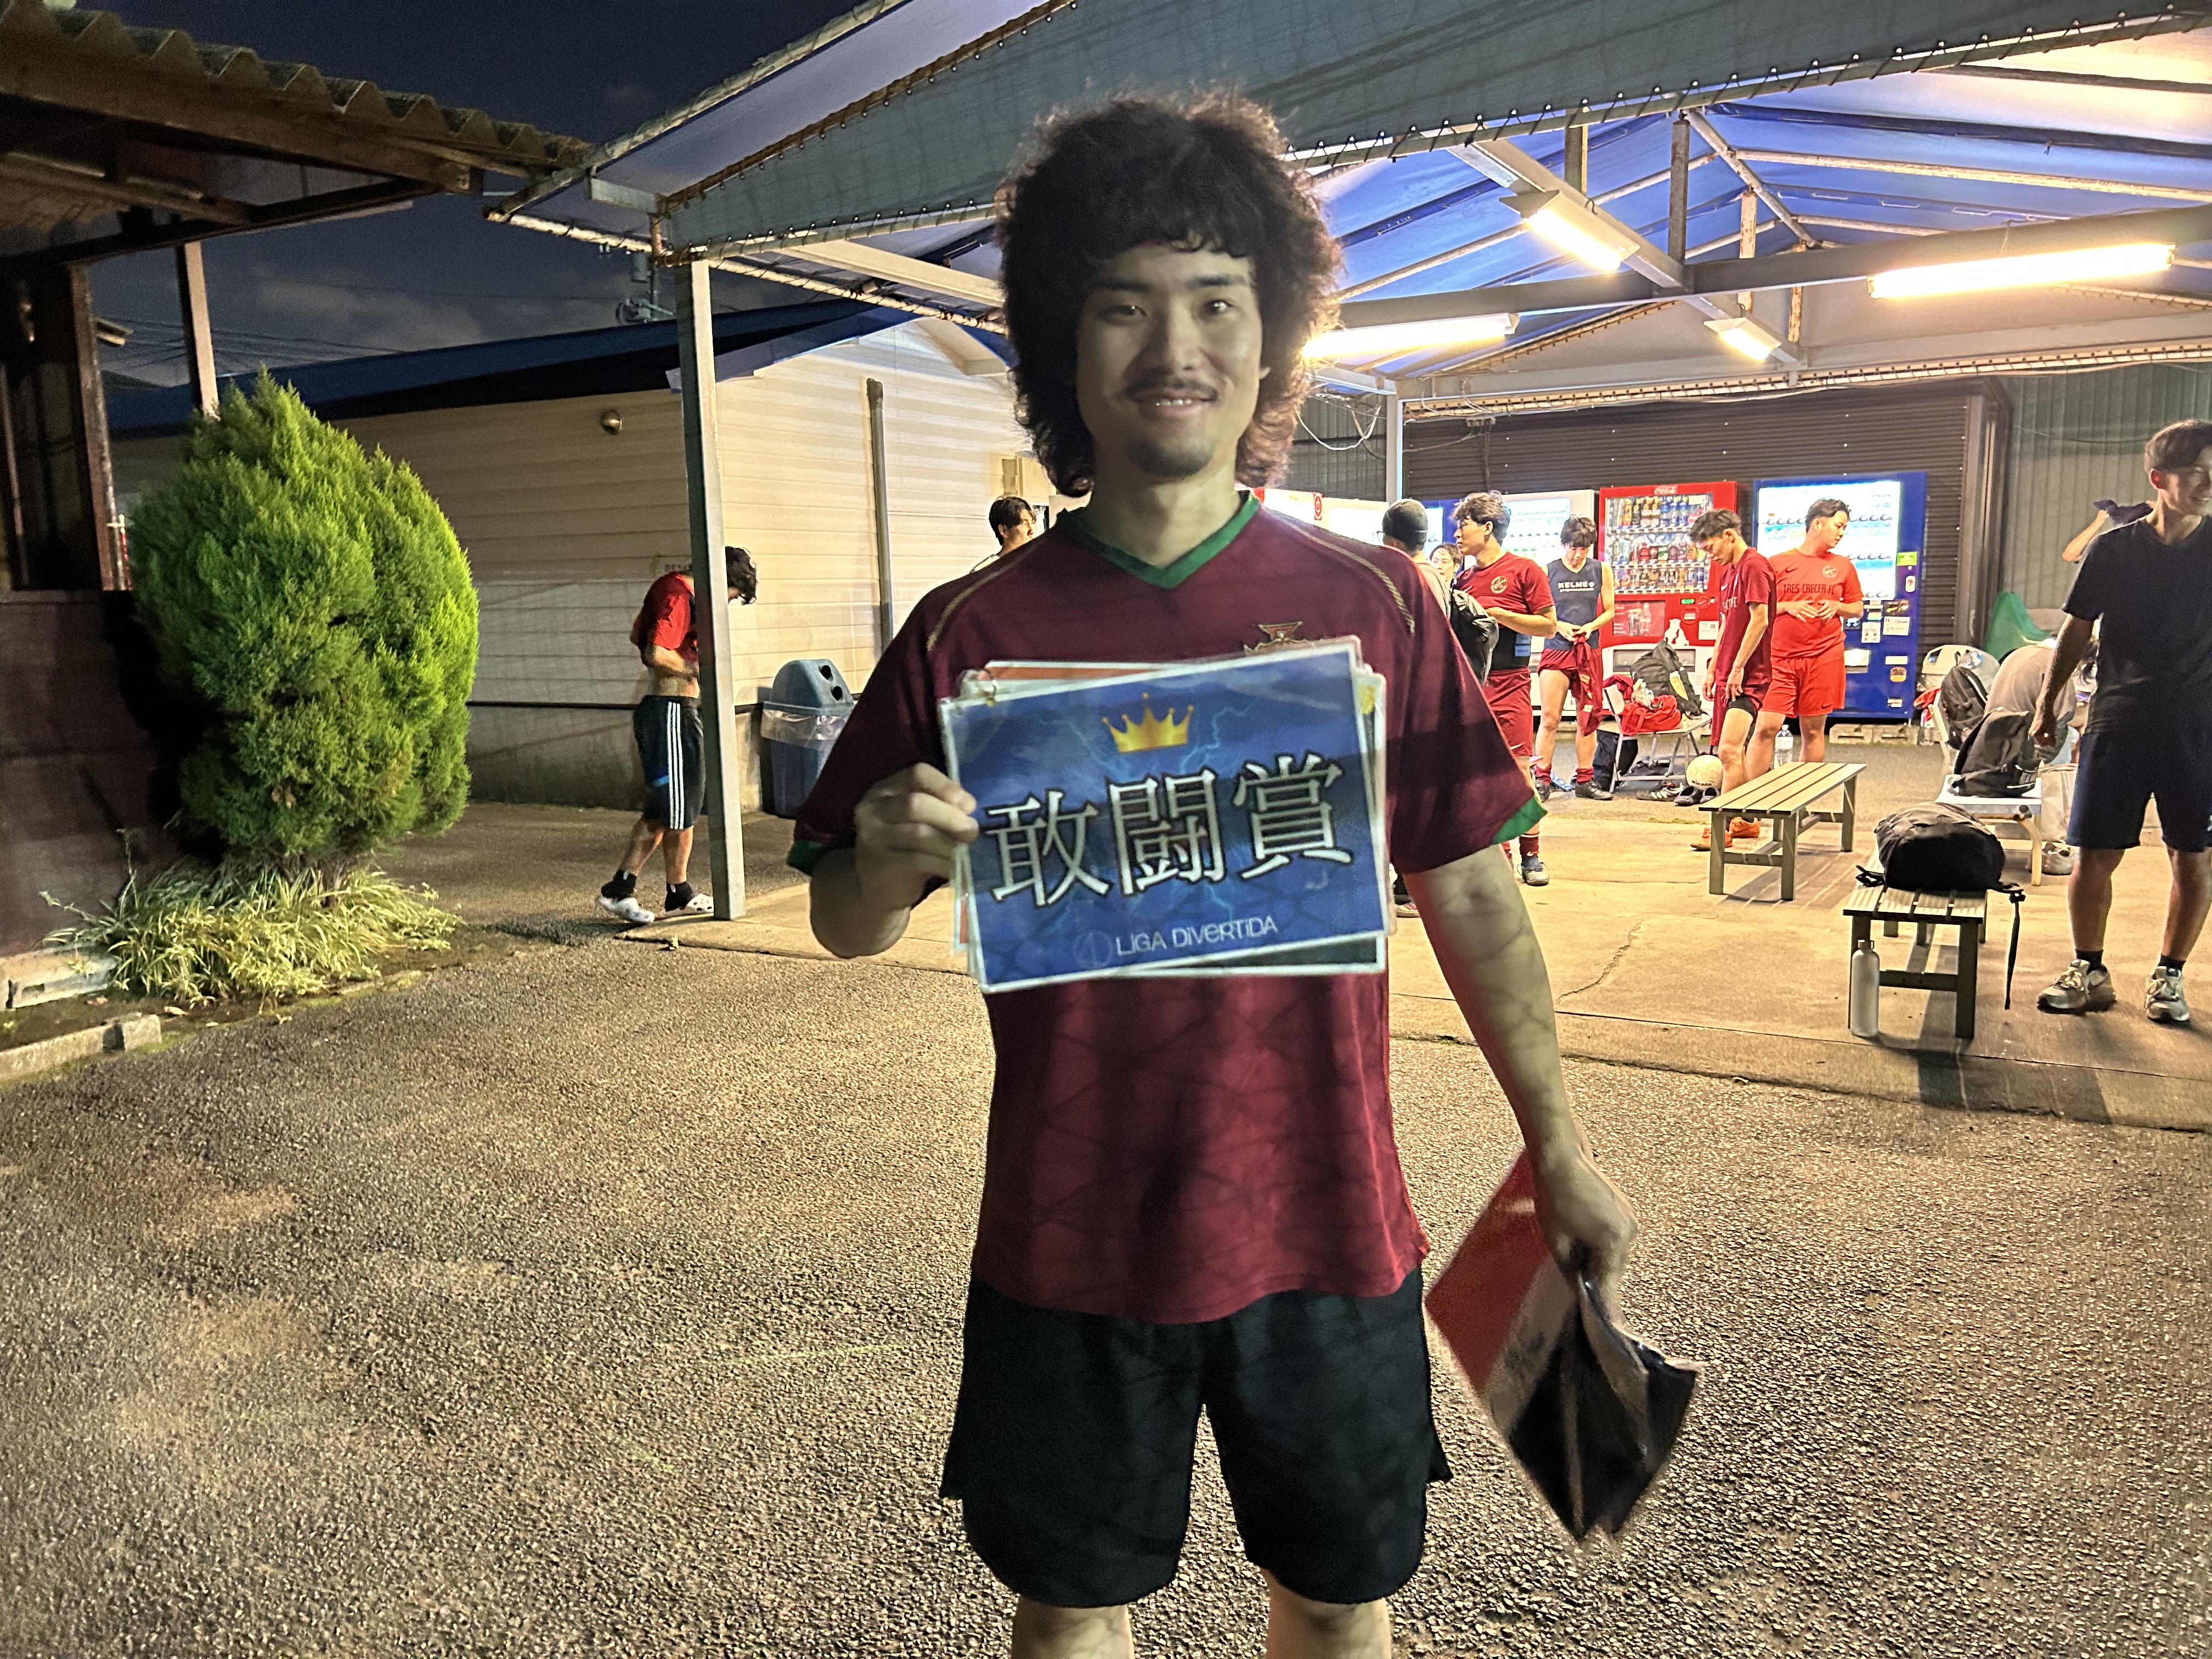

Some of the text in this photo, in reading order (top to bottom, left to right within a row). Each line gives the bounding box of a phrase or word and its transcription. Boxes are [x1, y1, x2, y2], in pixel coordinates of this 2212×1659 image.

[1783, 584, 1800, 594] TRES
[1802, 584, 1826, 594] CRECER
[986, 753, 1353, 906] 敢闘賞
[1115, 931, 1167, 956] LIGA
